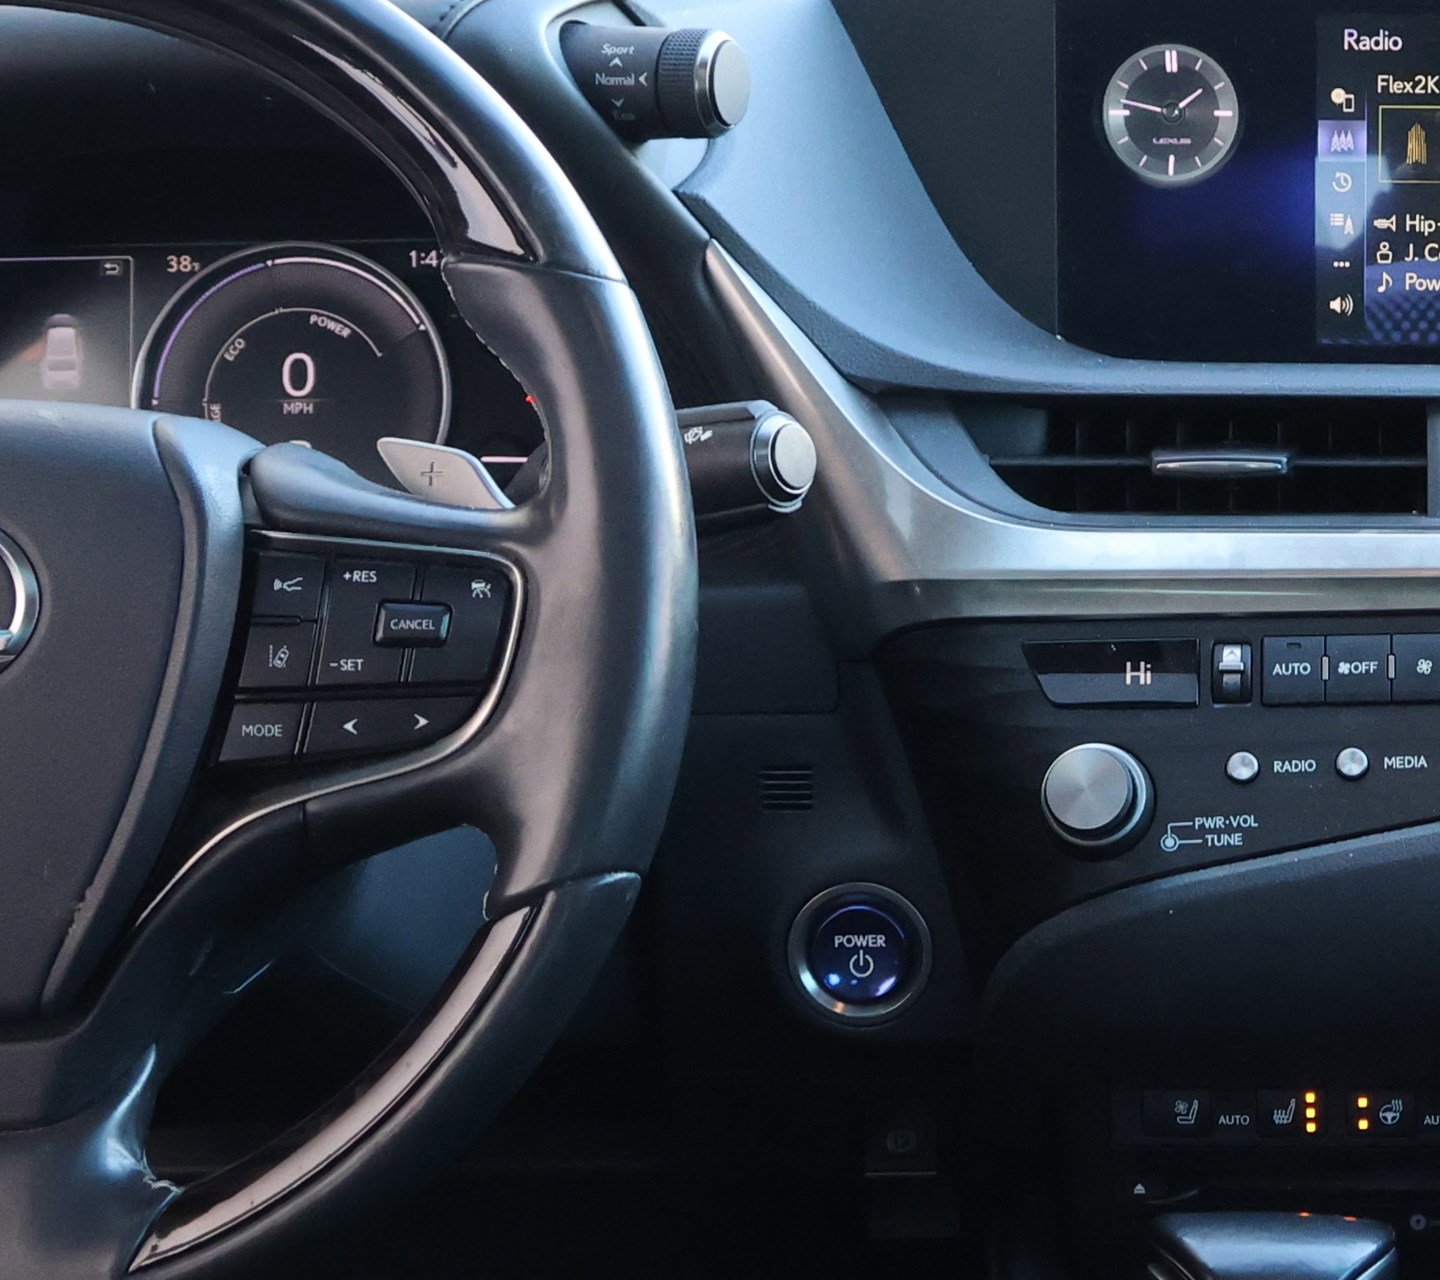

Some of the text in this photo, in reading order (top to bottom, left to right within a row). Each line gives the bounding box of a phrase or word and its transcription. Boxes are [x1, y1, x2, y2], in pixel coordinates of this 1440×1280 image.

[1343, 28, 1403, 51] Radio
[601, 42, 635, 56] Sport
[594, 72, 635, 86] Normal
[1377, 74, 1440, 94] Flex2K
[1404, 244, 1419, 262] J.
[308, 314, 353, 340] POWER
[223, 337, 247, 362] ECO
[282, 352, 316, 398] 0
[283, 403, 313, 415] MPH
[390, 618, 436, 631] CANCEL
[1125, 661, 1152, 685] Hi
[1273, 662, 1311, 676] AUTO
[1351, 661, 1378, 674] OFF
[241, 724, 283, 738] MODE
[1273, 759, 1316, 773] RADIO
[1384, 755, 1428, 770] MEDIA
[1205, 833, 1243, 847] TUNE
[834, 934, 886, 948] POWER
[1218, 1114, 1250, 1125] AUTO
